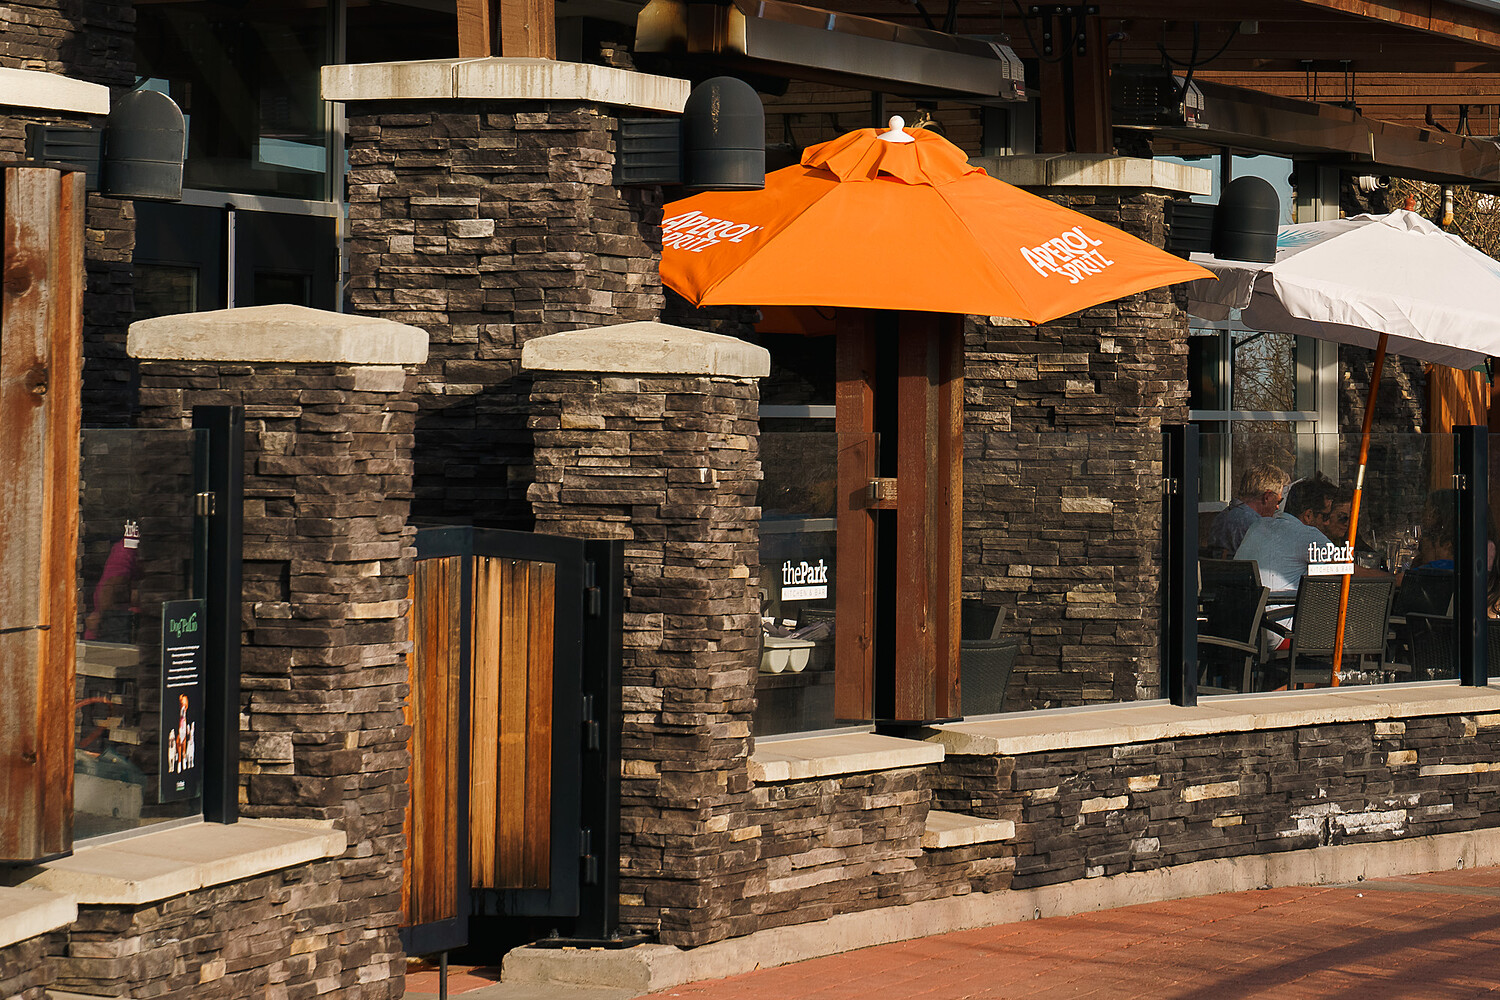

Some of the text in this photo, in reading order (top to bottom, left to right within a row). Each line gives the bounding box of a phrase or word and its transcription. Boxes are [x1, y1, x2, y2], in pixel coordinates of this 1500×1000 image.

[1020, 226, 1103, 278] APEROL
[1308, 541, 1354, 562] thePark
[782, 559, 828, 585] thePark
